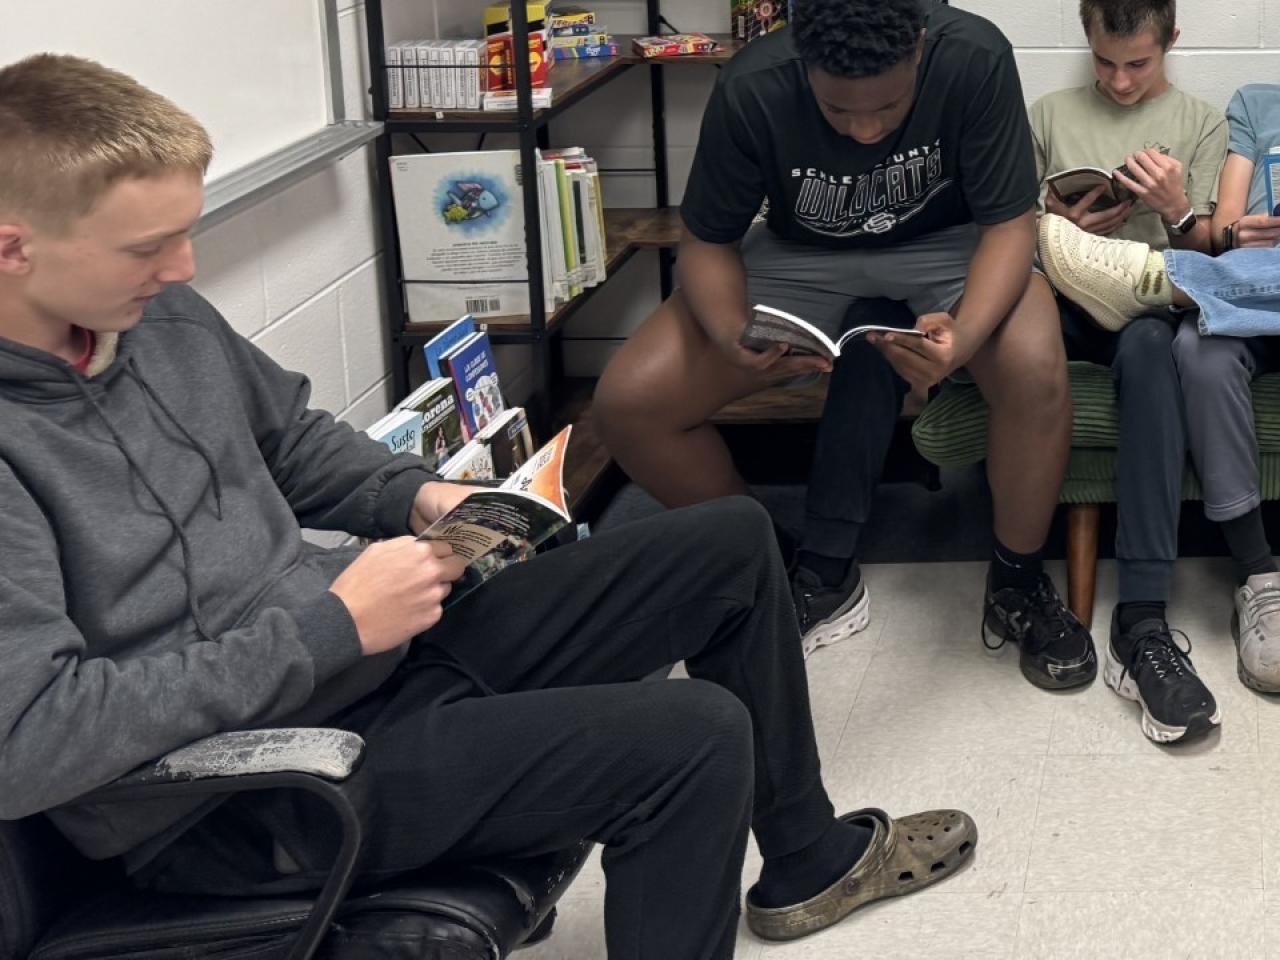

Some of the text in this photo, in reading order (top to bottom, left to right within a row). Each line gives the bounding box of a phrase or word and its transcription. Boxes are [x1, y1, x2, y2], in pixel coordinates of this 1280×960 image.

[792, 167, 862, 184] SCHLE
[795, 148, 942, 222] WILDCATS
[424, 395, 454, 423] orena
[391, 429, 415, 452] Susto
